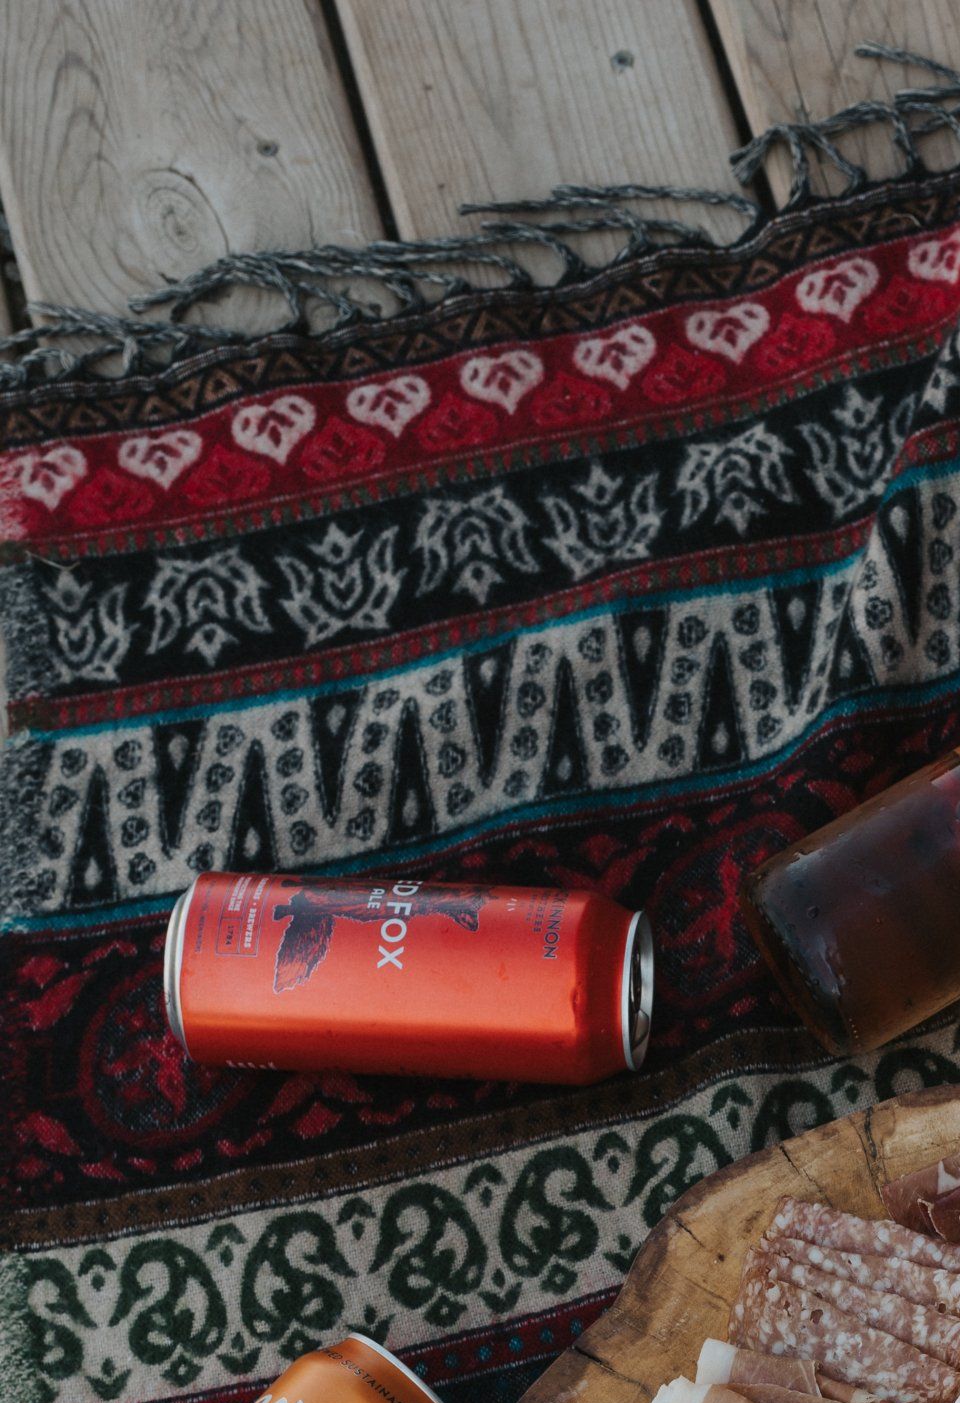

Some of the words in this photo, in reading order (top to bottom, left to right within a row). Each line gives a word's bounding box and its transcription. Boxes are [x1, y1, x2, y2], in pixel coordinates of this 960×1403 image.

[366, 888, 385, 910] ALE
[244, 908, 257, 949] BREWERS
[377, 903, 410, 970] FOX
